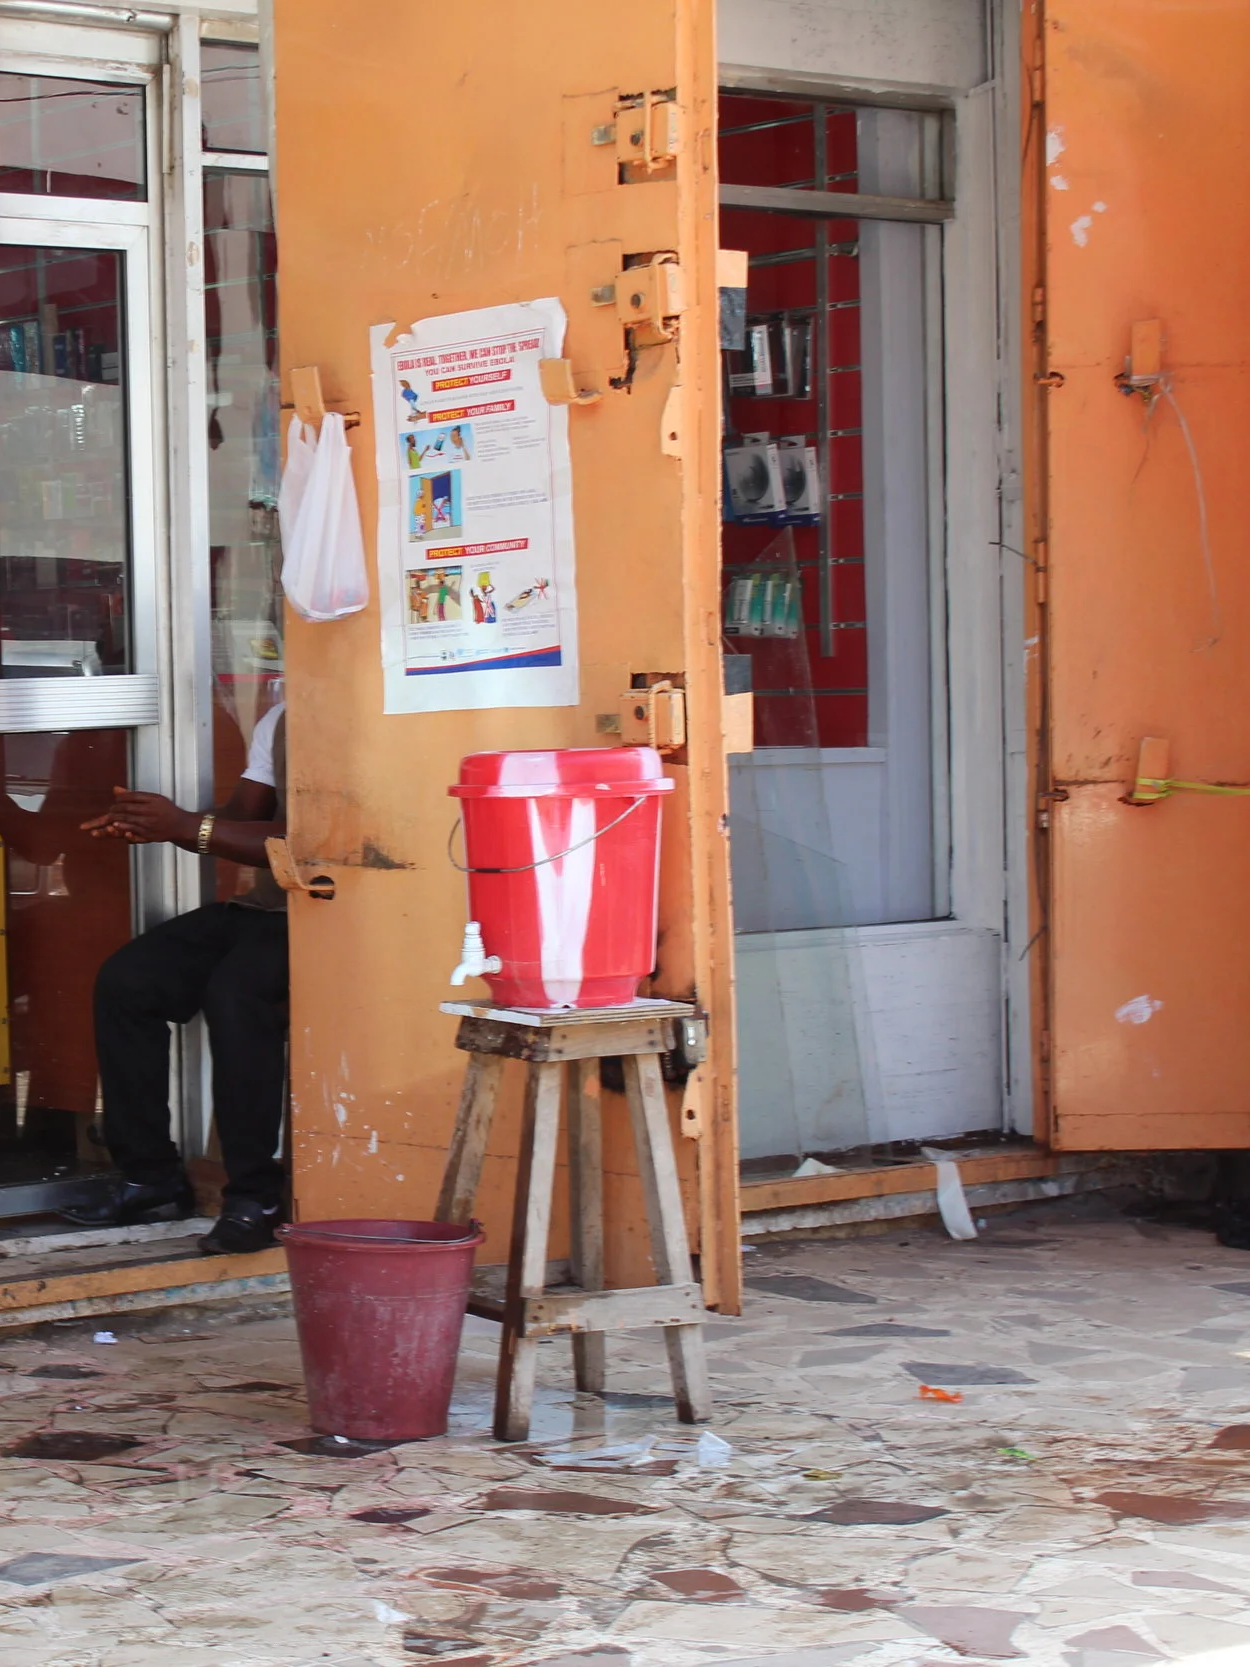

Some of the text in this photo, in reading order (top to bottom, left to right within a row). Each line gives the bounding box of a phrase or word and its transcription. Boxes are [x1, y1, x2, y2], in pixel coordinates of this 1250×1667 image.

[425, 368, 438, 376] YOU
[441, 365, 455, 374] CAN
[458, 360, 488, 371] SURVIVE
[435, 371, 508, 390] PROTECT YOURSELF
[433, 402, 513, 421] PROTECT YOUR FAMILY
[429, 540, 527, 558] PROTECT YOUR COMMUNITY
